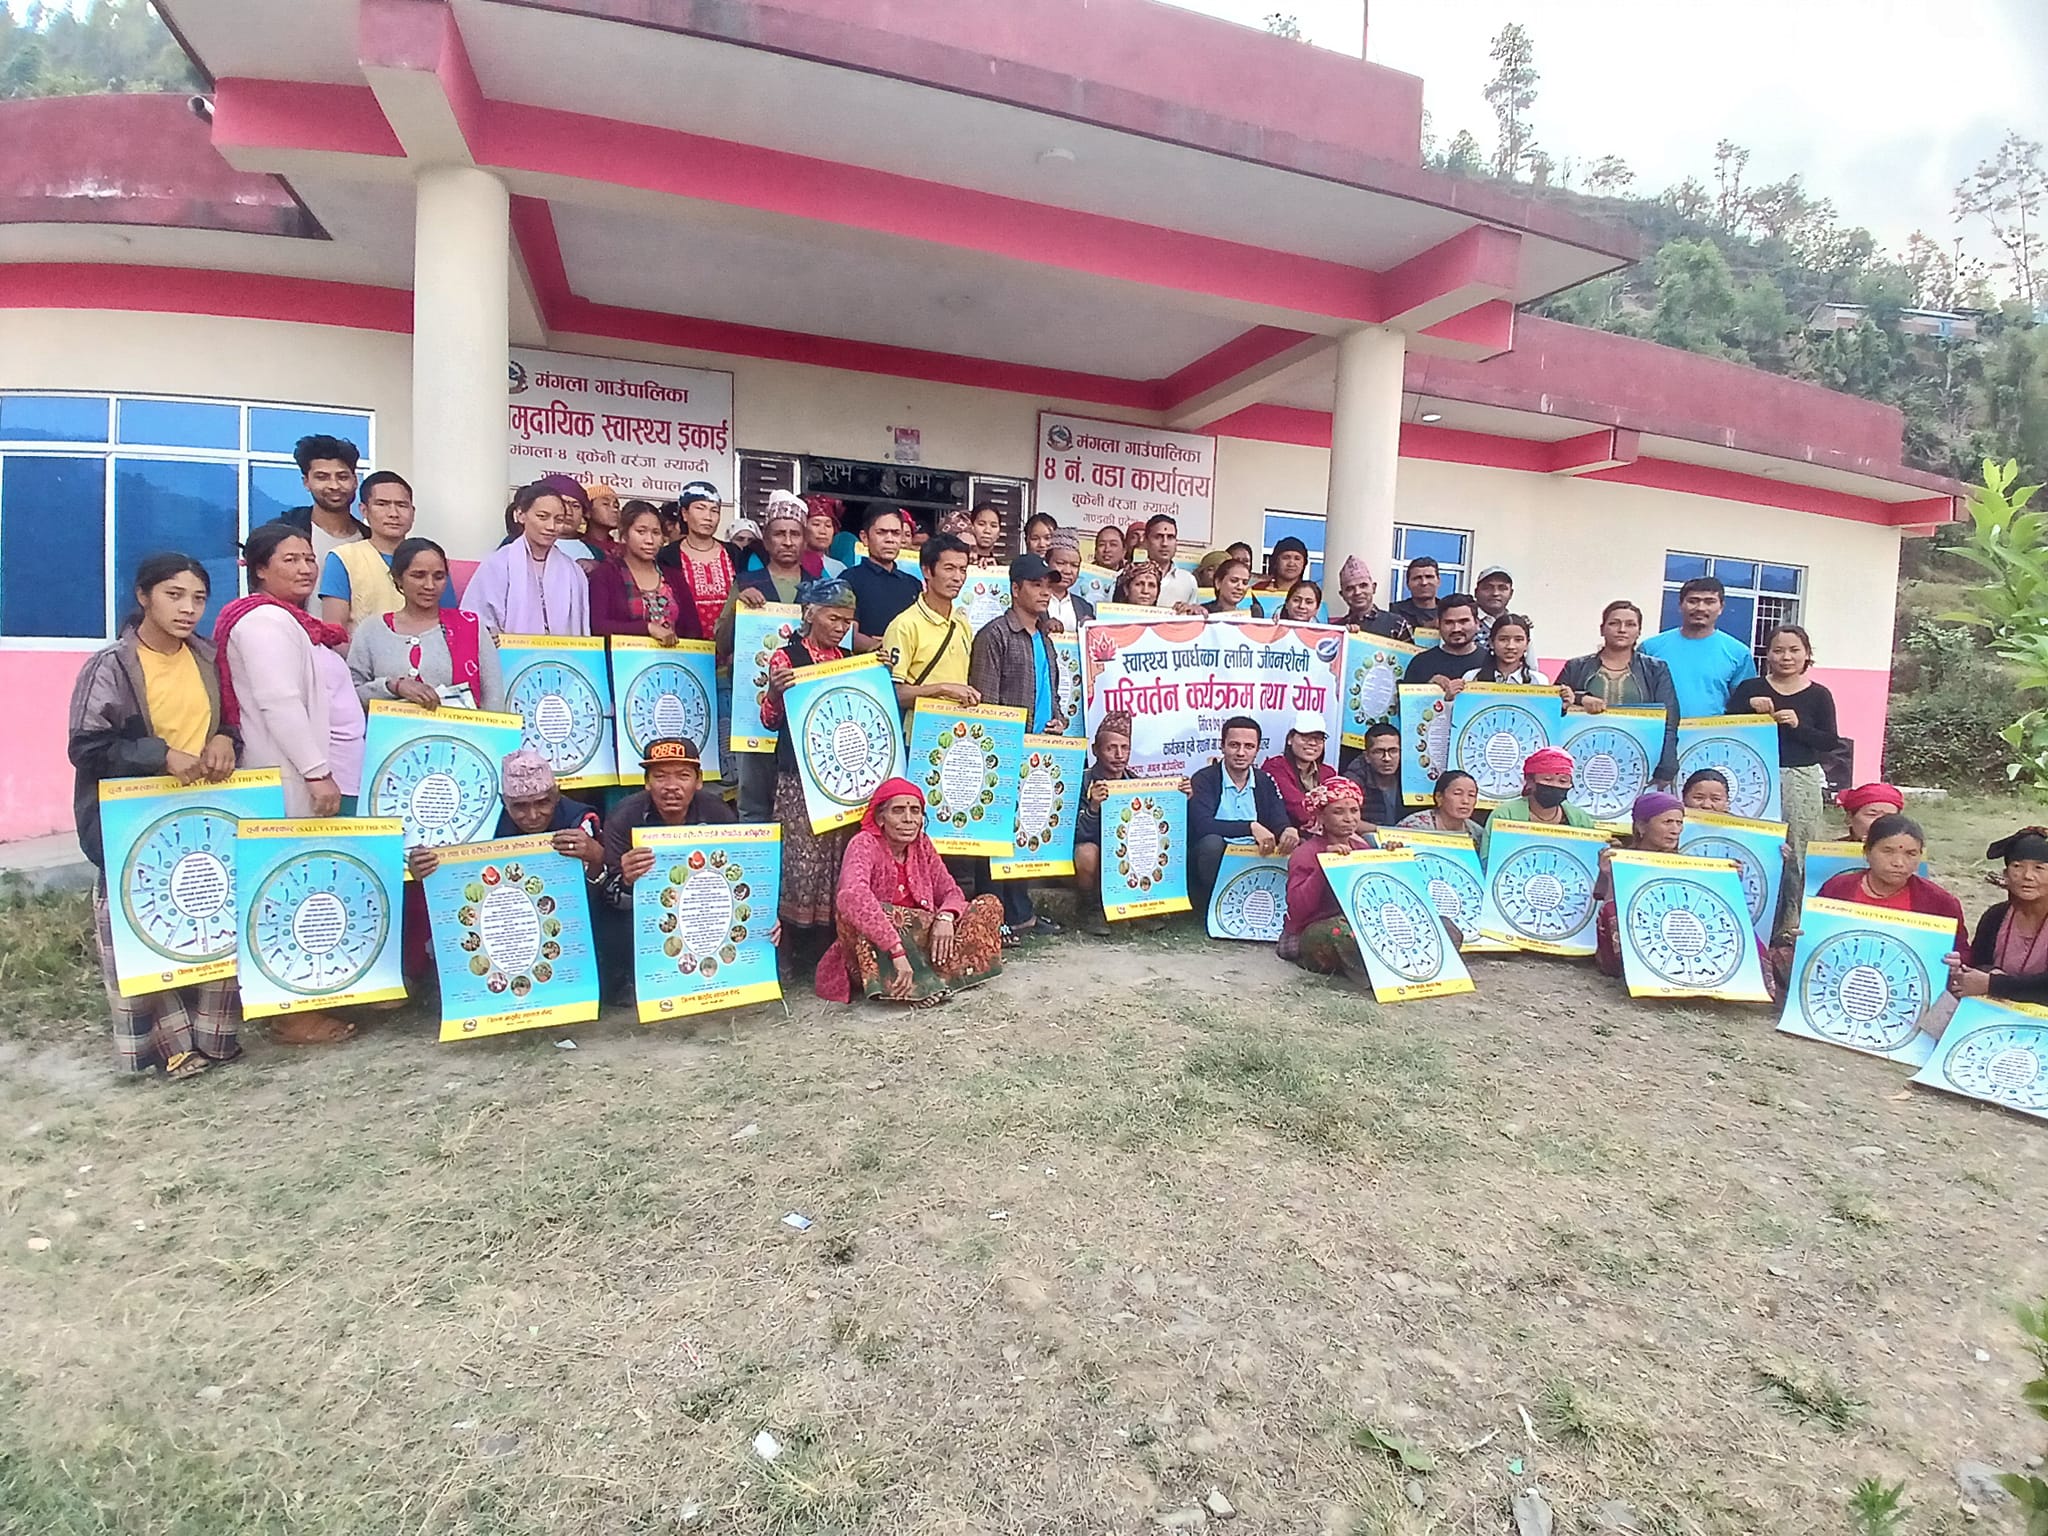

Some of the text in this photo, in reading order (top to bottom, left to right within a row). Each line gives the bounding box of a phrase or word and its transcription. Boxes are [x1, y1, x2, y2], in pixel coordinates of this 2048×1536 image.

[535, 371, 588, 393] मंगला
[601, 414, 672, 446] स्वास्थ्य
[678, 419, 729, 455] इकाई
[1076, 433, 1120, 454] मंगला
[823, 462, 931, 489] शुभ लाभ
[1044, 456, 1211, 499] ४ नं. वडा कार्यालय
[1122, 651, 1168, 674] स्वास्थ्य
[1224, 644, 1254, 669] लागि
[1104, 677, 1179, 717] परिवर्तन
[1293, 676, 1326, 713] योग
